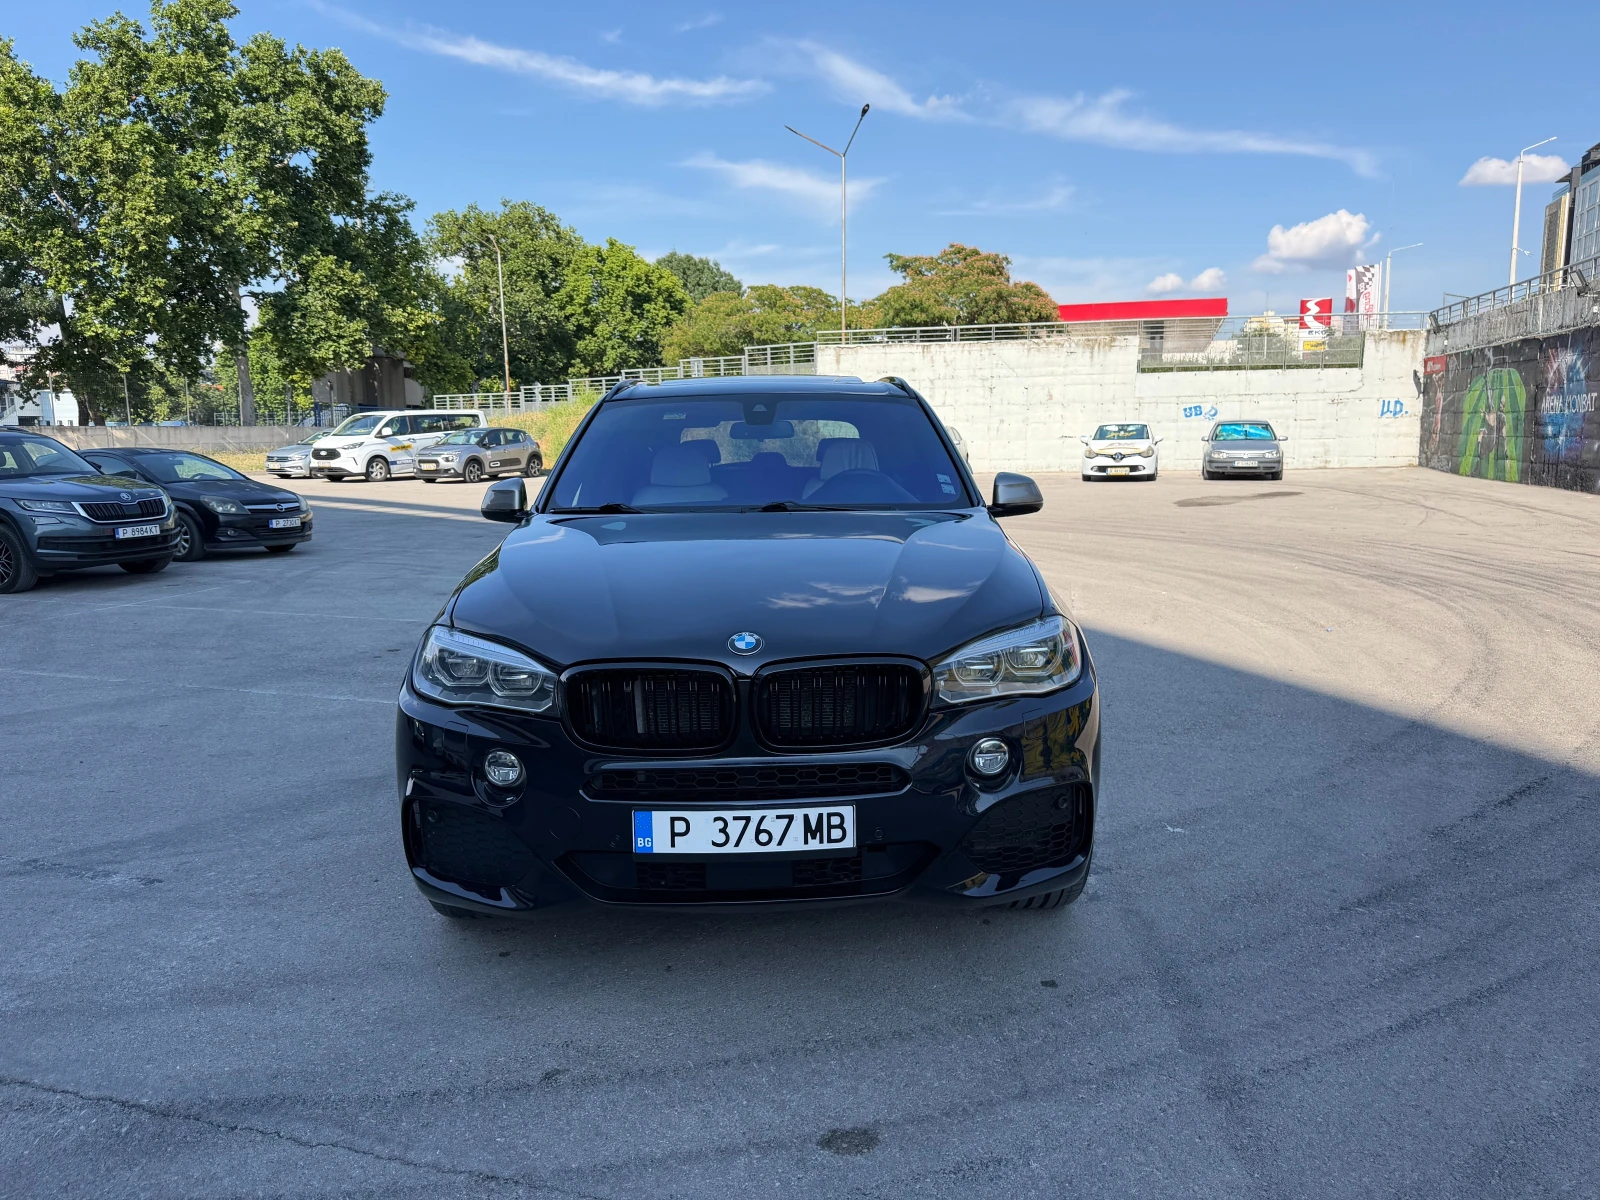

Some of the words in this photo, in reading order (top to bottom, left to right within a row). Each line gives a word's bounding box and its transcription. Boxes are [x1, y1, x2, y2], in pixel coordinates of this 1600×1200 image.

[669, 816, 691, 848] P
[711, 814, 795, 848] 3767
[803, 812, 847, 845] MB
[637, 837, 652, 848] BG
